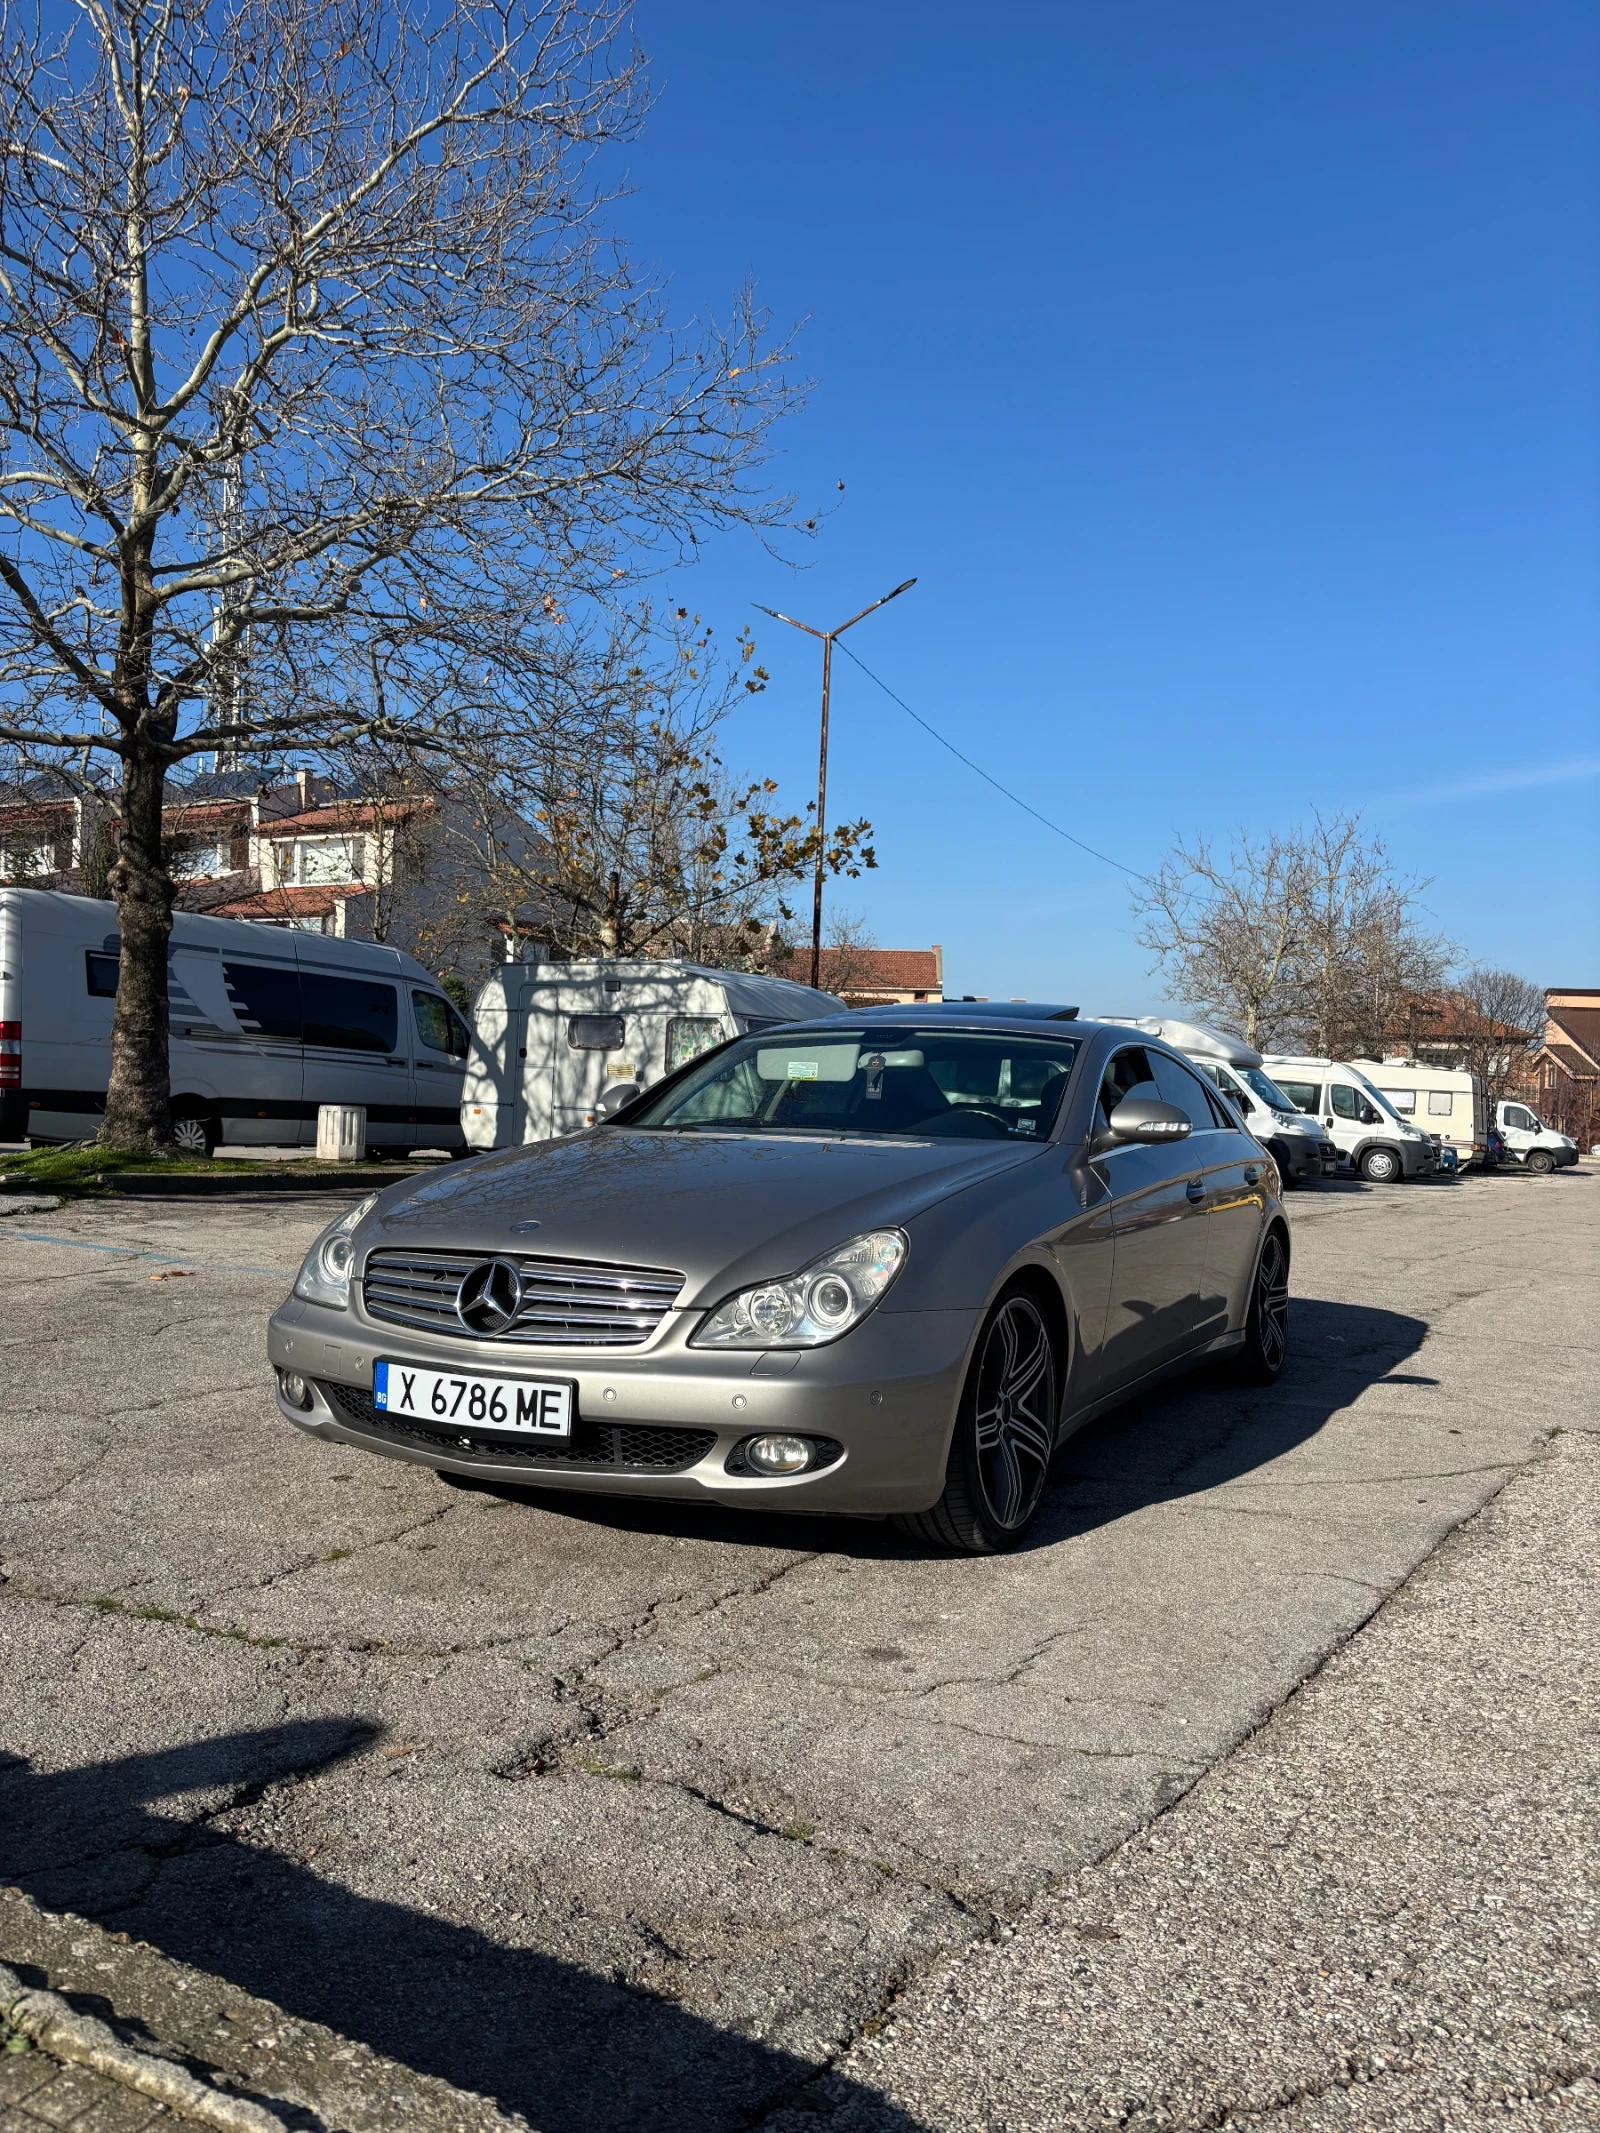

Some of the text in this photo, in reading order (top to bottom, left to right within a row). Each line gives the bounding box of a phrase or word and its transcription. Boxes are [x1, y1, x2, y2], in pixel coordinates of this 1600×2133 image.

[377, 1391, 387, 1404] BG
[400, 1371, 562, 1430] X 6786 ME
